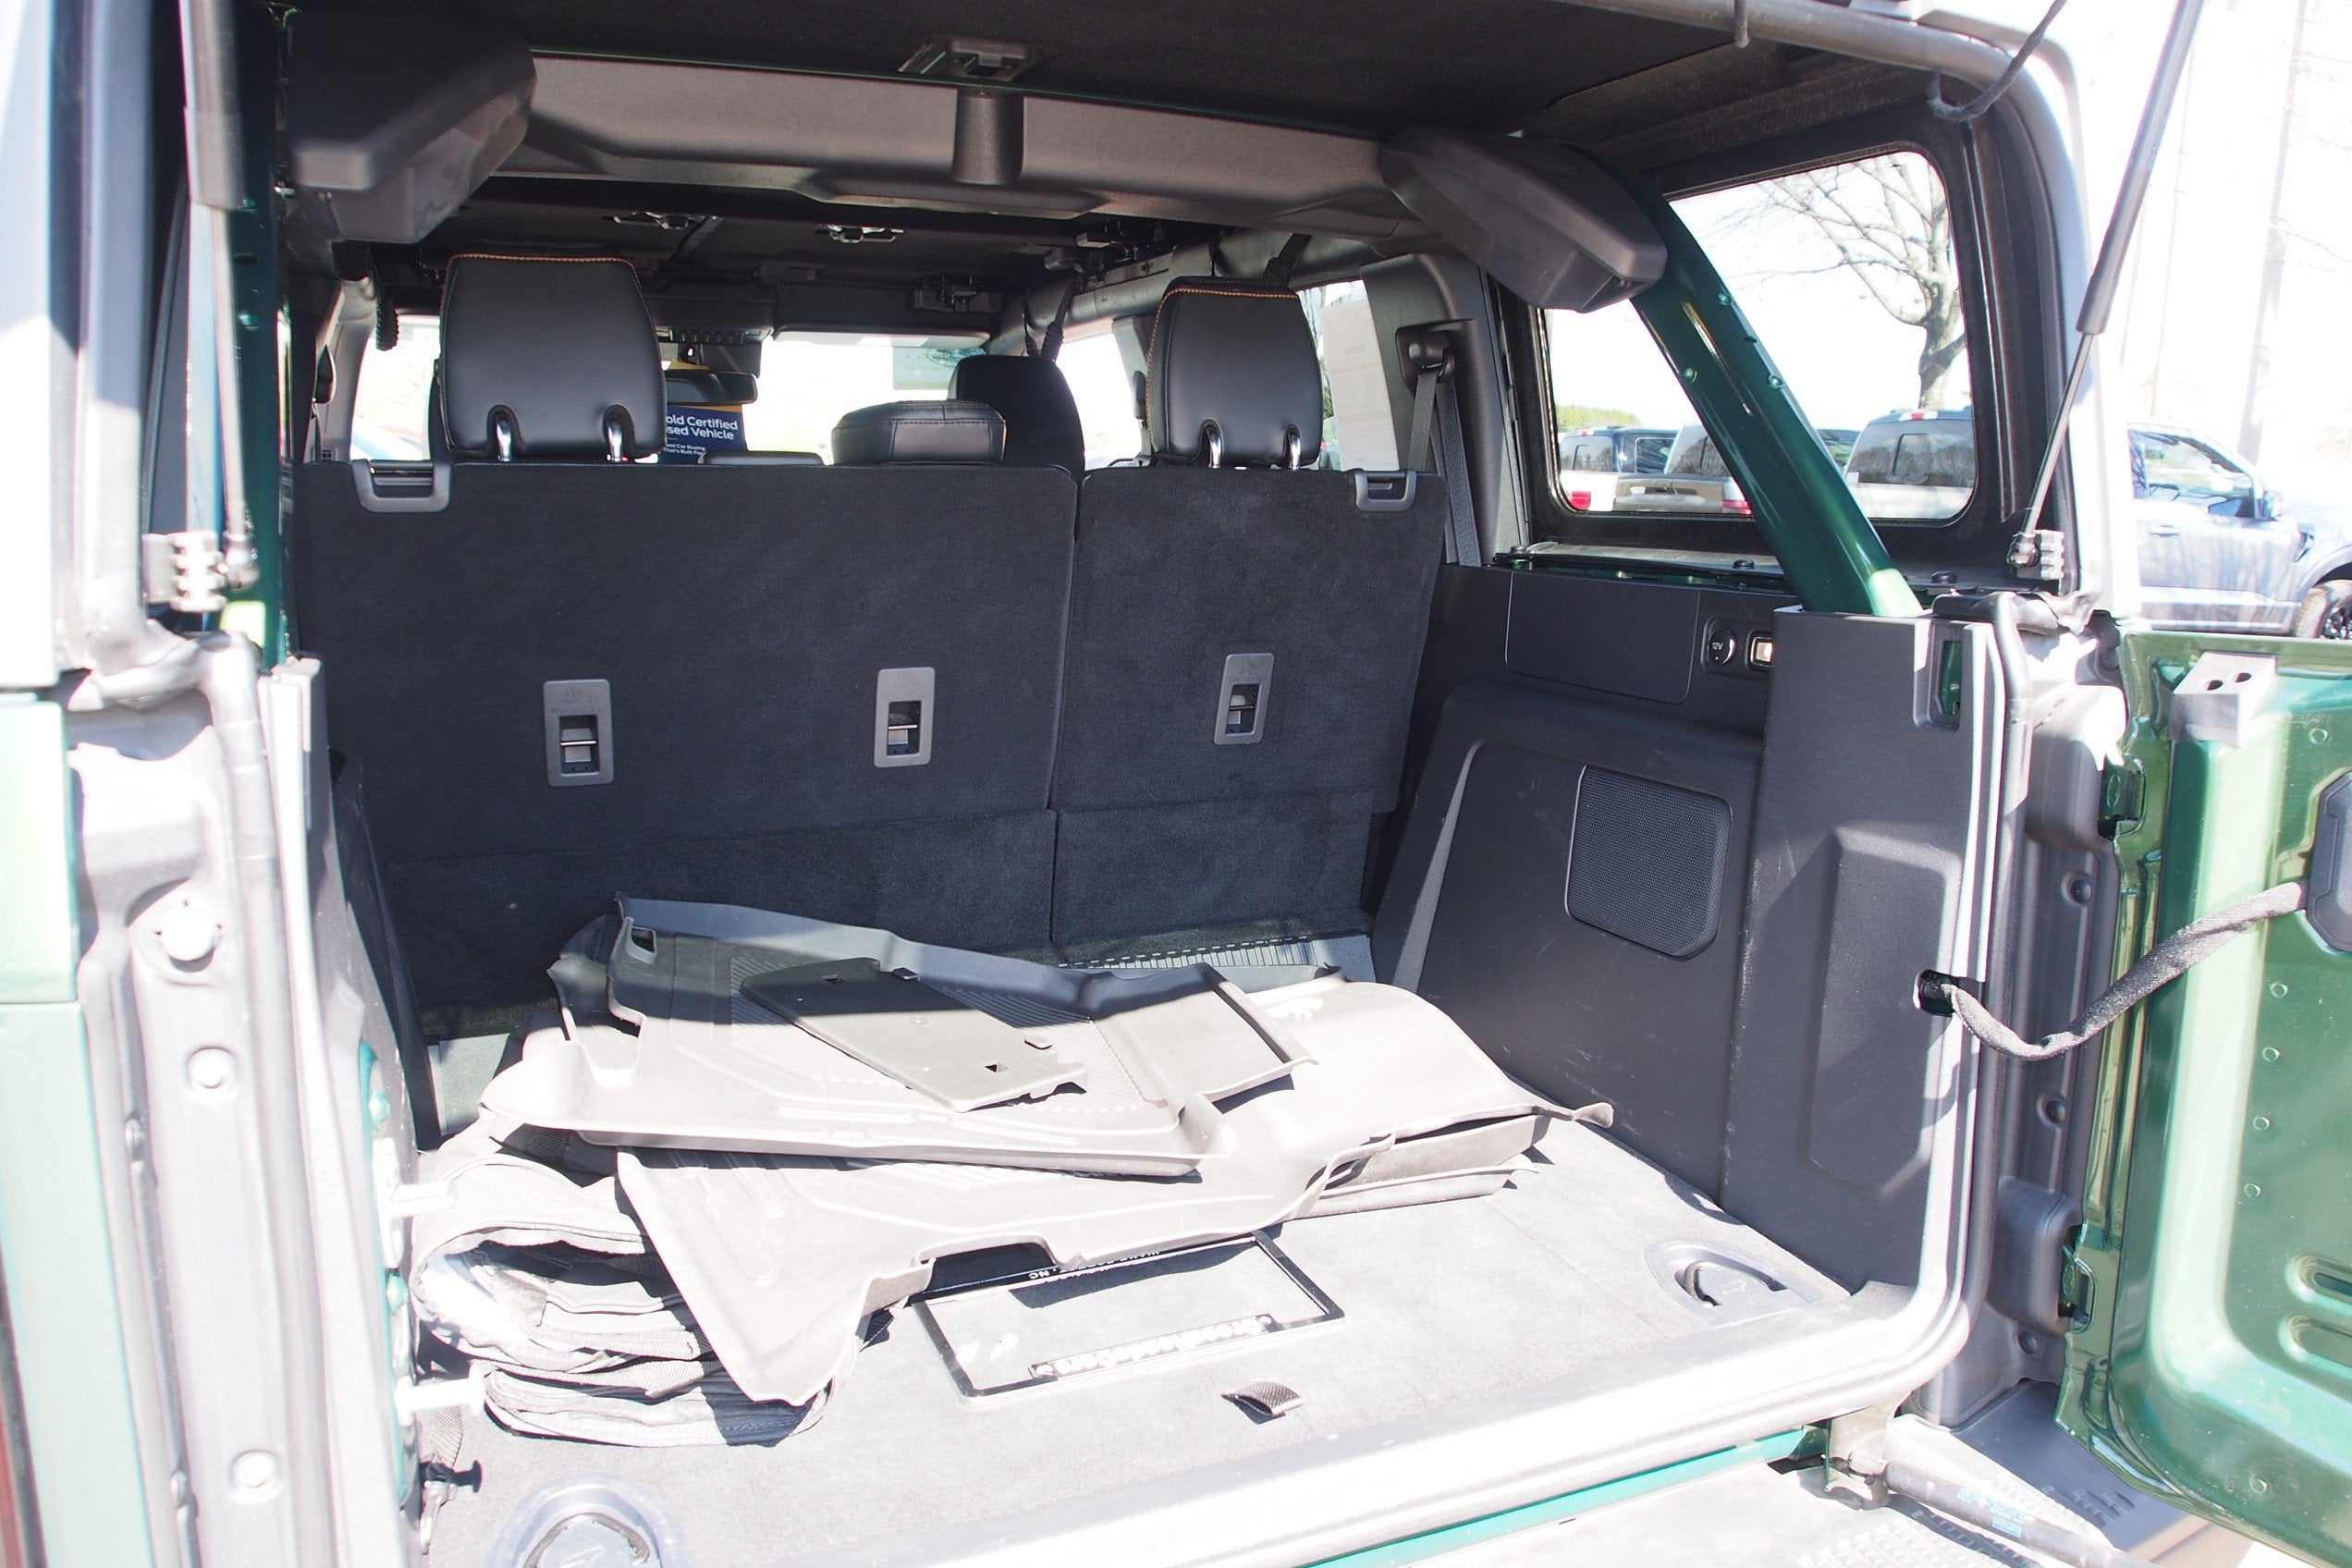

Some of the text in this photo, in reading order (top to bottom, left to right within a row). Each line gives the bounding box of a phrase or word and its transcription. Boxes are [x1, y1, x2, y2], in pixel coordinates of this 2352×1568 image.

[666, 414, 738, 430] old Certified
[666, 426, 734, 439] sed Vehicle
[1712, 642, 1723, 650] 12V
